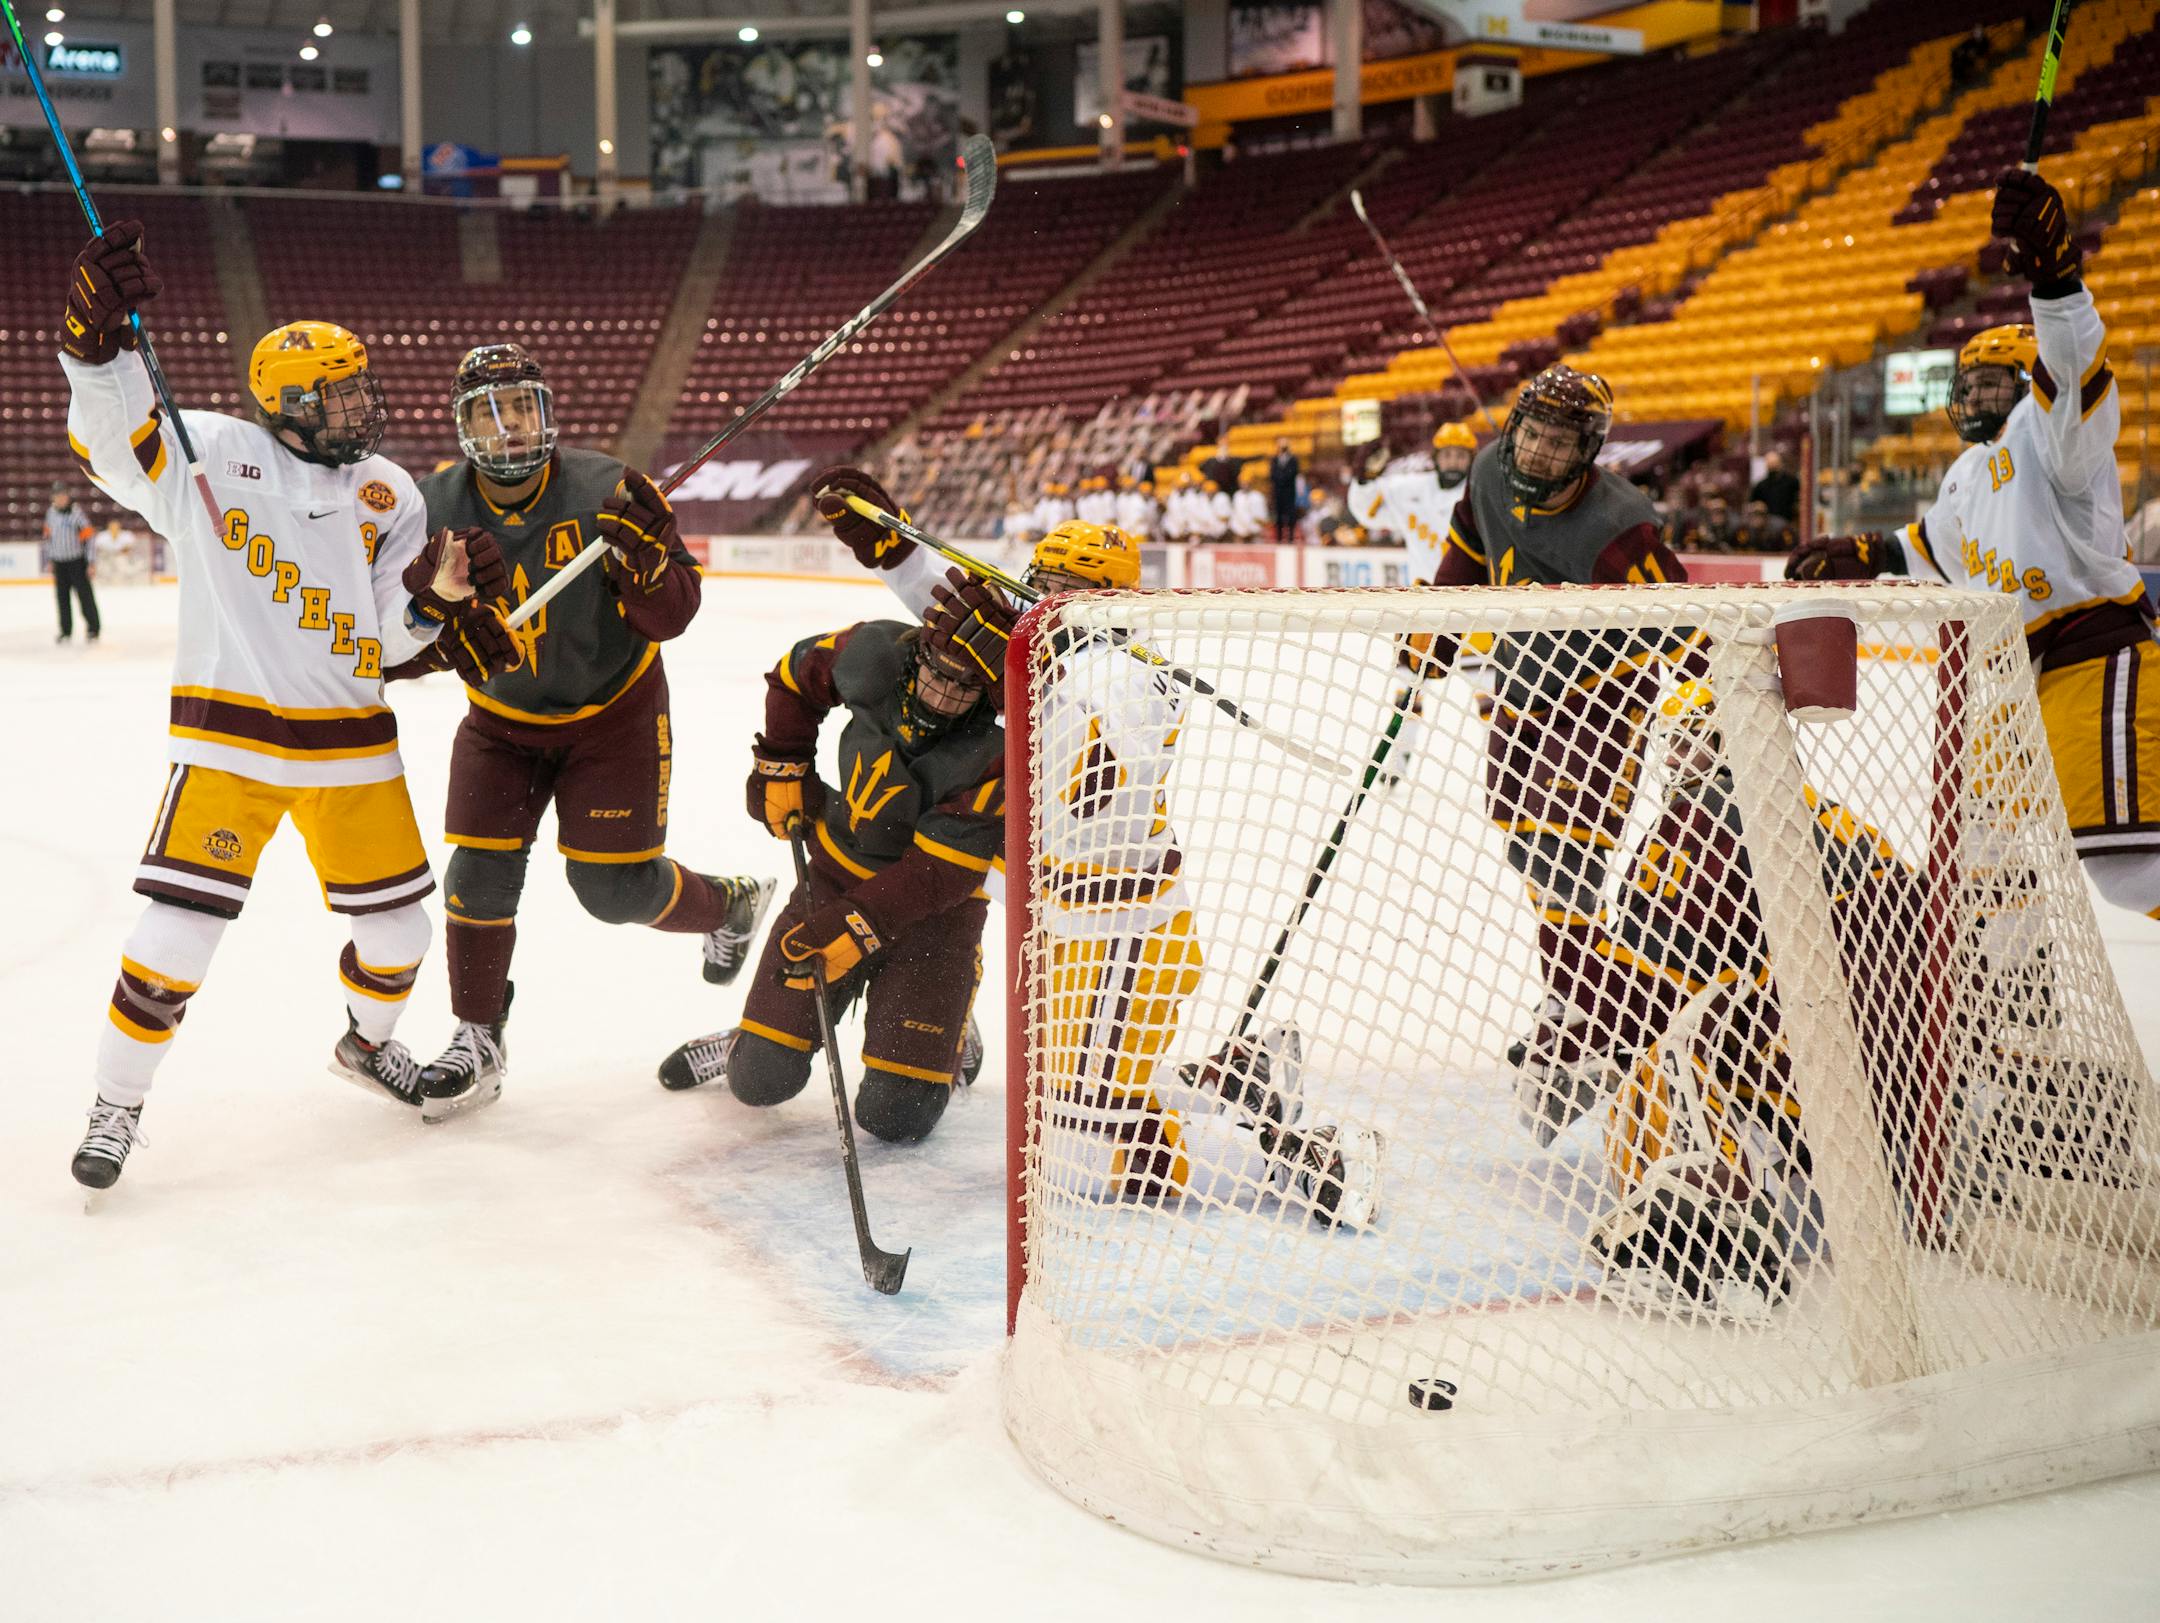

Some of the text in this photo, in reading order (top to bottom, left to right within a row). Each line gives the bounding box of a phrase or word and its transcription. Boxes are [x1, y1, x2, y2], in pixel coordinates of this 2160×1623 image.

[49, 45, 119, 72] Arena
[279, 331, 315, 351] M
[652, 460, 813, 501] 3M
[360, 488, 397, 507] 100
[555, 530, 576, 562] A
[657, 713, 671, 828] SUN DEVILS
[755, 758, 809, 778] CM
[588, 809, 633, 819] CCM
[206, 837, 242, 855] 100
[902, 1019, 945, 1035] CCM
